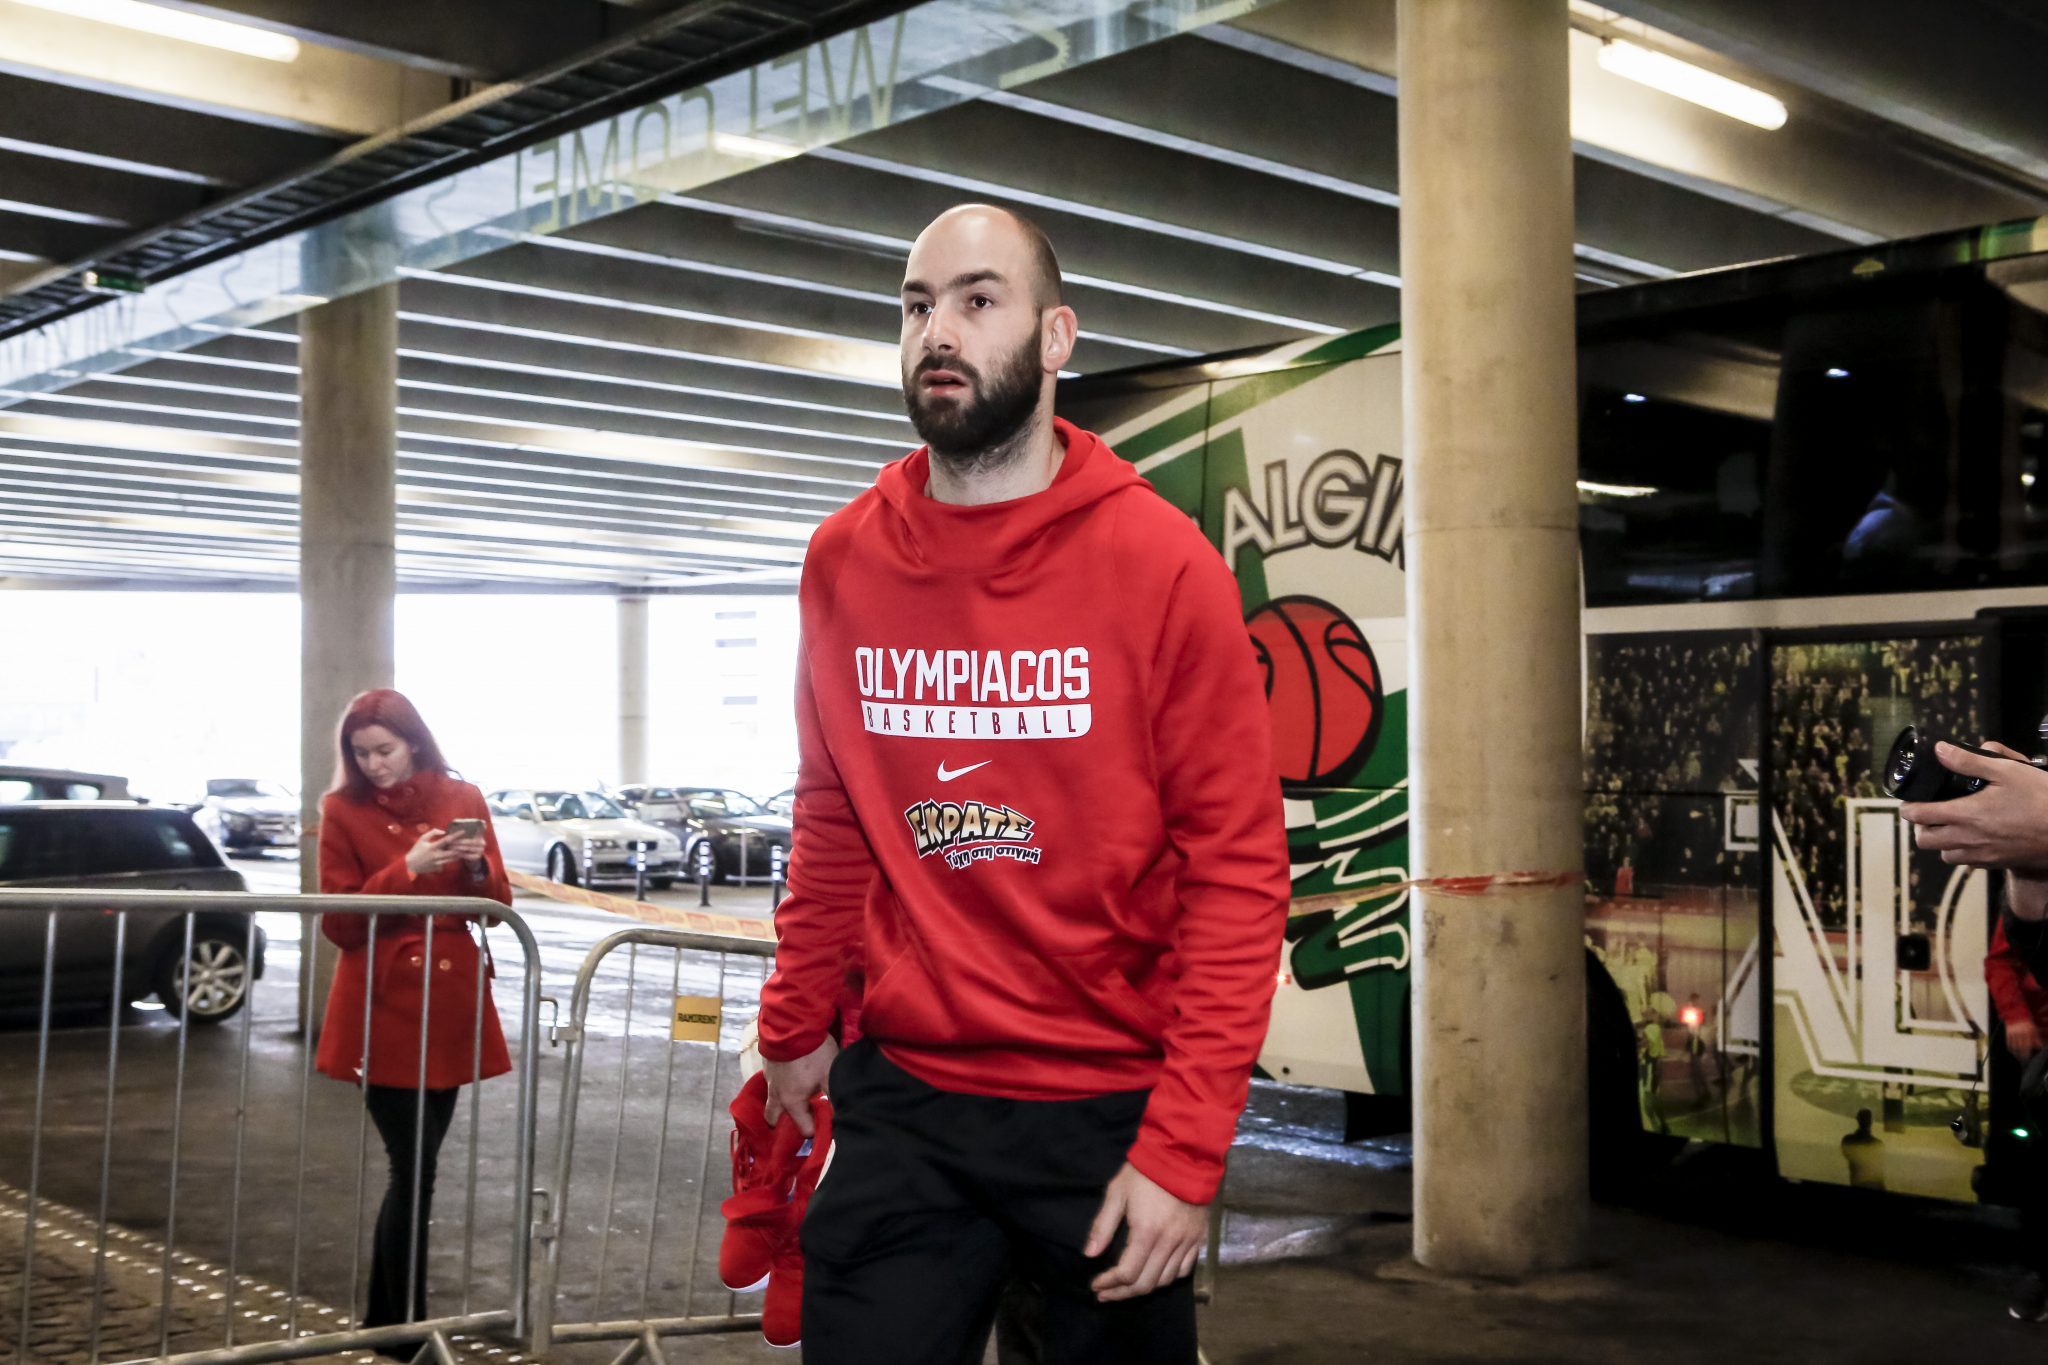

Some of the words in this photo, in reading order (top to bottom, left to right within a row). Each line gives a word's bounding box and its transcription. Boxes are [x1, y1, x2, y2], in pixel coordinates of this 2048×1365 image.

[1192, 449, 1406, 572] ALGI
[855, 646, 1090, 702] OLYMPIACOS
[867, 705, 1076, 735] BASKETBALL
[971, 845, 995, 861] στη
[995, 845, 1042, 865] στιγμή
